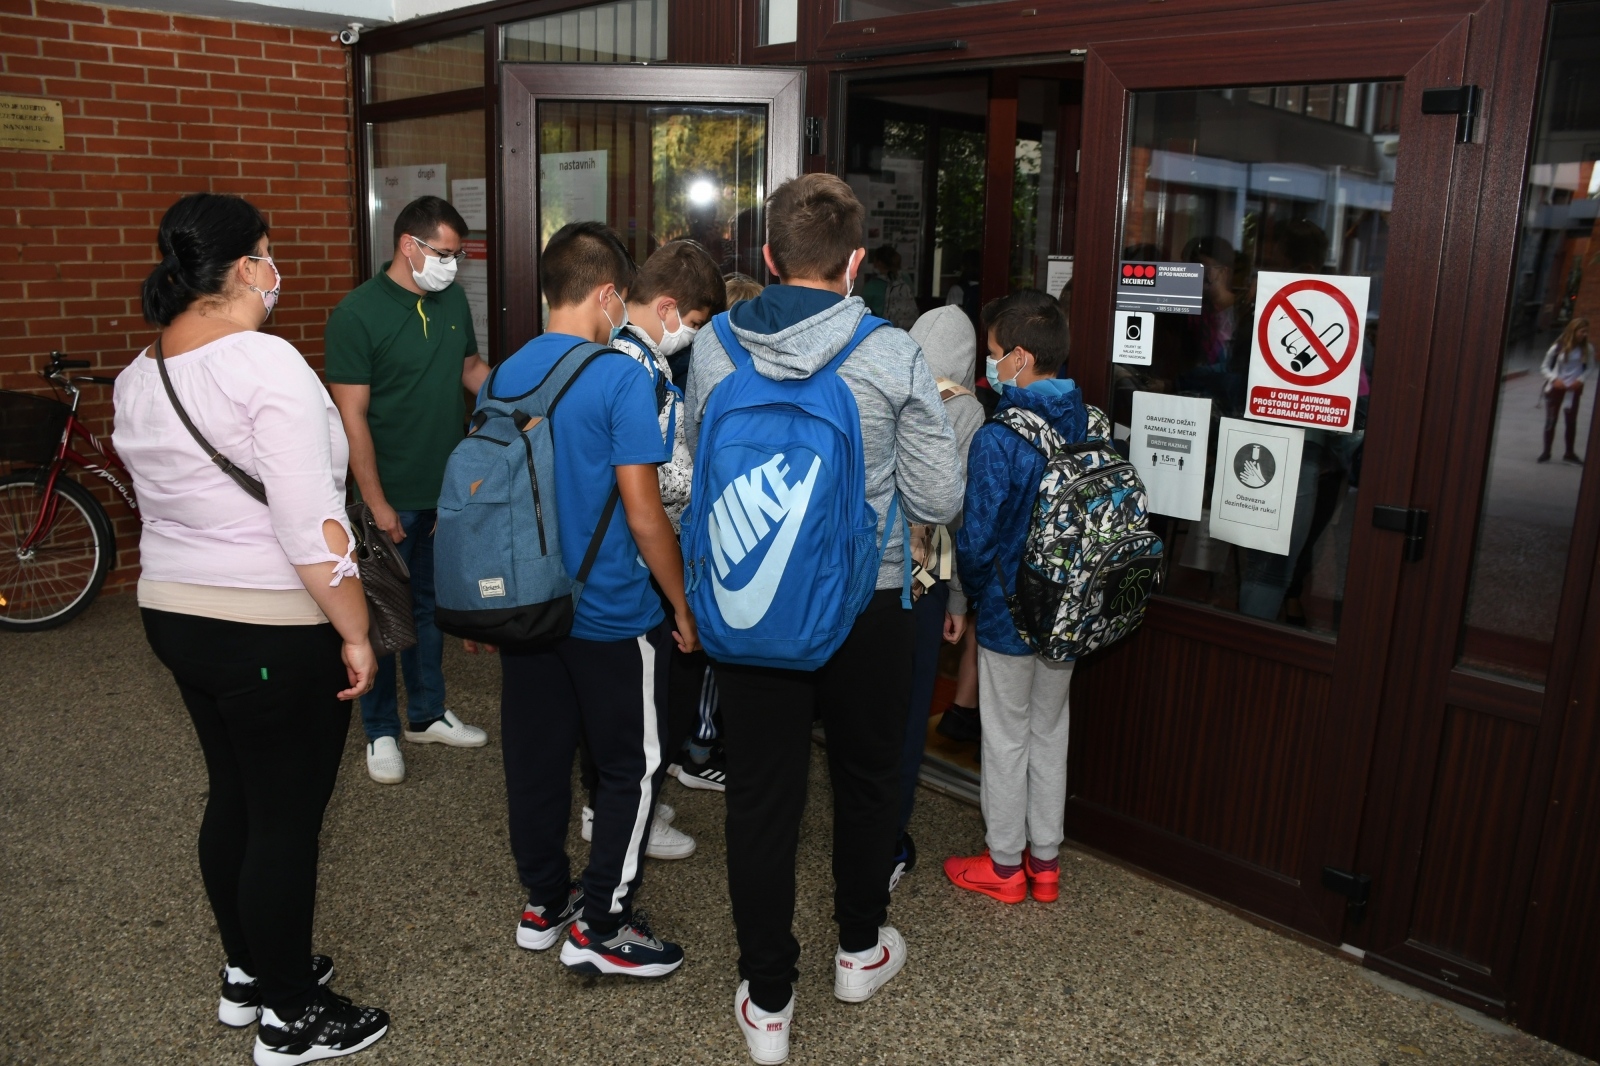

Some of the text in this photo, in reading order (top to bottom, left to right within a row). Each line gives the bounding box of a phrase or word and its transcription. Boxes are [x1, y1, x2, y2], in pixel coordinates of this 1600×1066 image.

[559, 157, 596, 171] nastavnih
[417, 168, 436, 180] drugih
[1122, 278, 1155, 286] SECURITAS
[1270, 391, 1331, 406] U OVOM JAVNOM
[1253, 397, 1291, 409] PROSTORU
[1300, 403, 1347, 416] POTPUNOSTI
[1146, 415, 1196, 427] OBAVEZNO DRŽATI
[1267, 407, 1314, 420] ZABRANJENO
[1316, 413, 1341, 424] PUŠITI
[1144, 424, 1197, 437] RAZMAK 1,5 METAR
[1150, 439, 1188, 450] DRŽITE RAZMAK
[97, 469, 137, 509] DOUGLAS
[1224, 499, 1259, 512] dezinfekcija
[1236, 493, 1266, 505] Obavezna
[708, 452, 801, 581] NIKE
[839, 958, 854, 970] NIKE
[766, 1021, 783, 1032] NIKE
